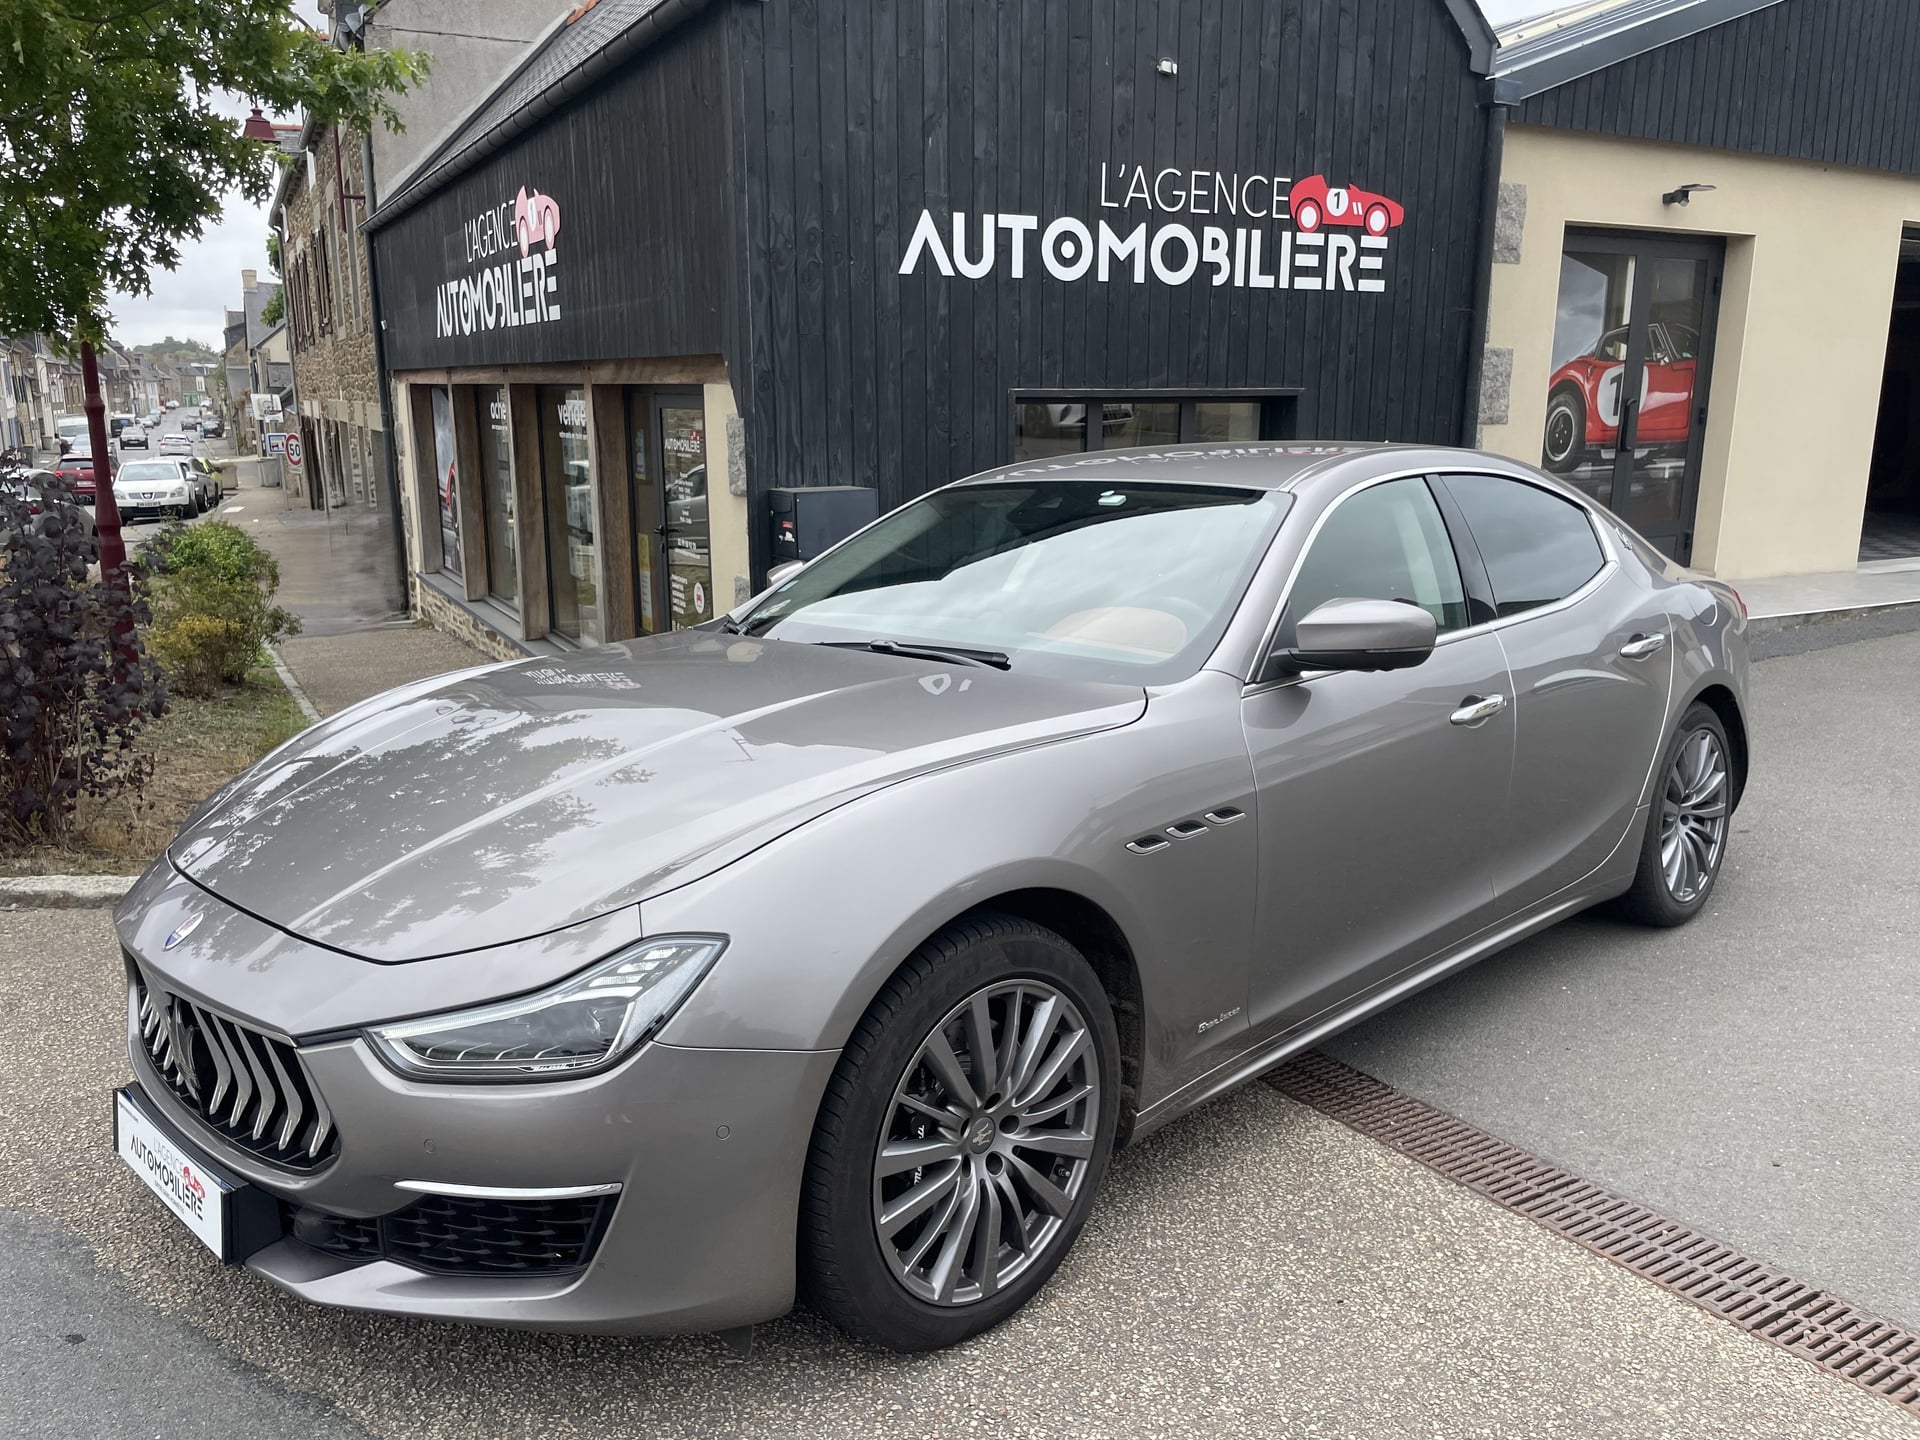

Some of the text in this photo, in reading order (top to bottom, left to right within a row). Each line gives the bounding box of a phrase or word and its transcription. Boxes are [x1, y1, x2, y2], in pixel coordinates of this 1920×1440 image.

[1099, 161, 1291, 220] L'AGENCE
[464, 199, 519, 263] L'AGENCE
[1609, 371, 1624, 417] 1
[289, 443, 301, 457] 50
